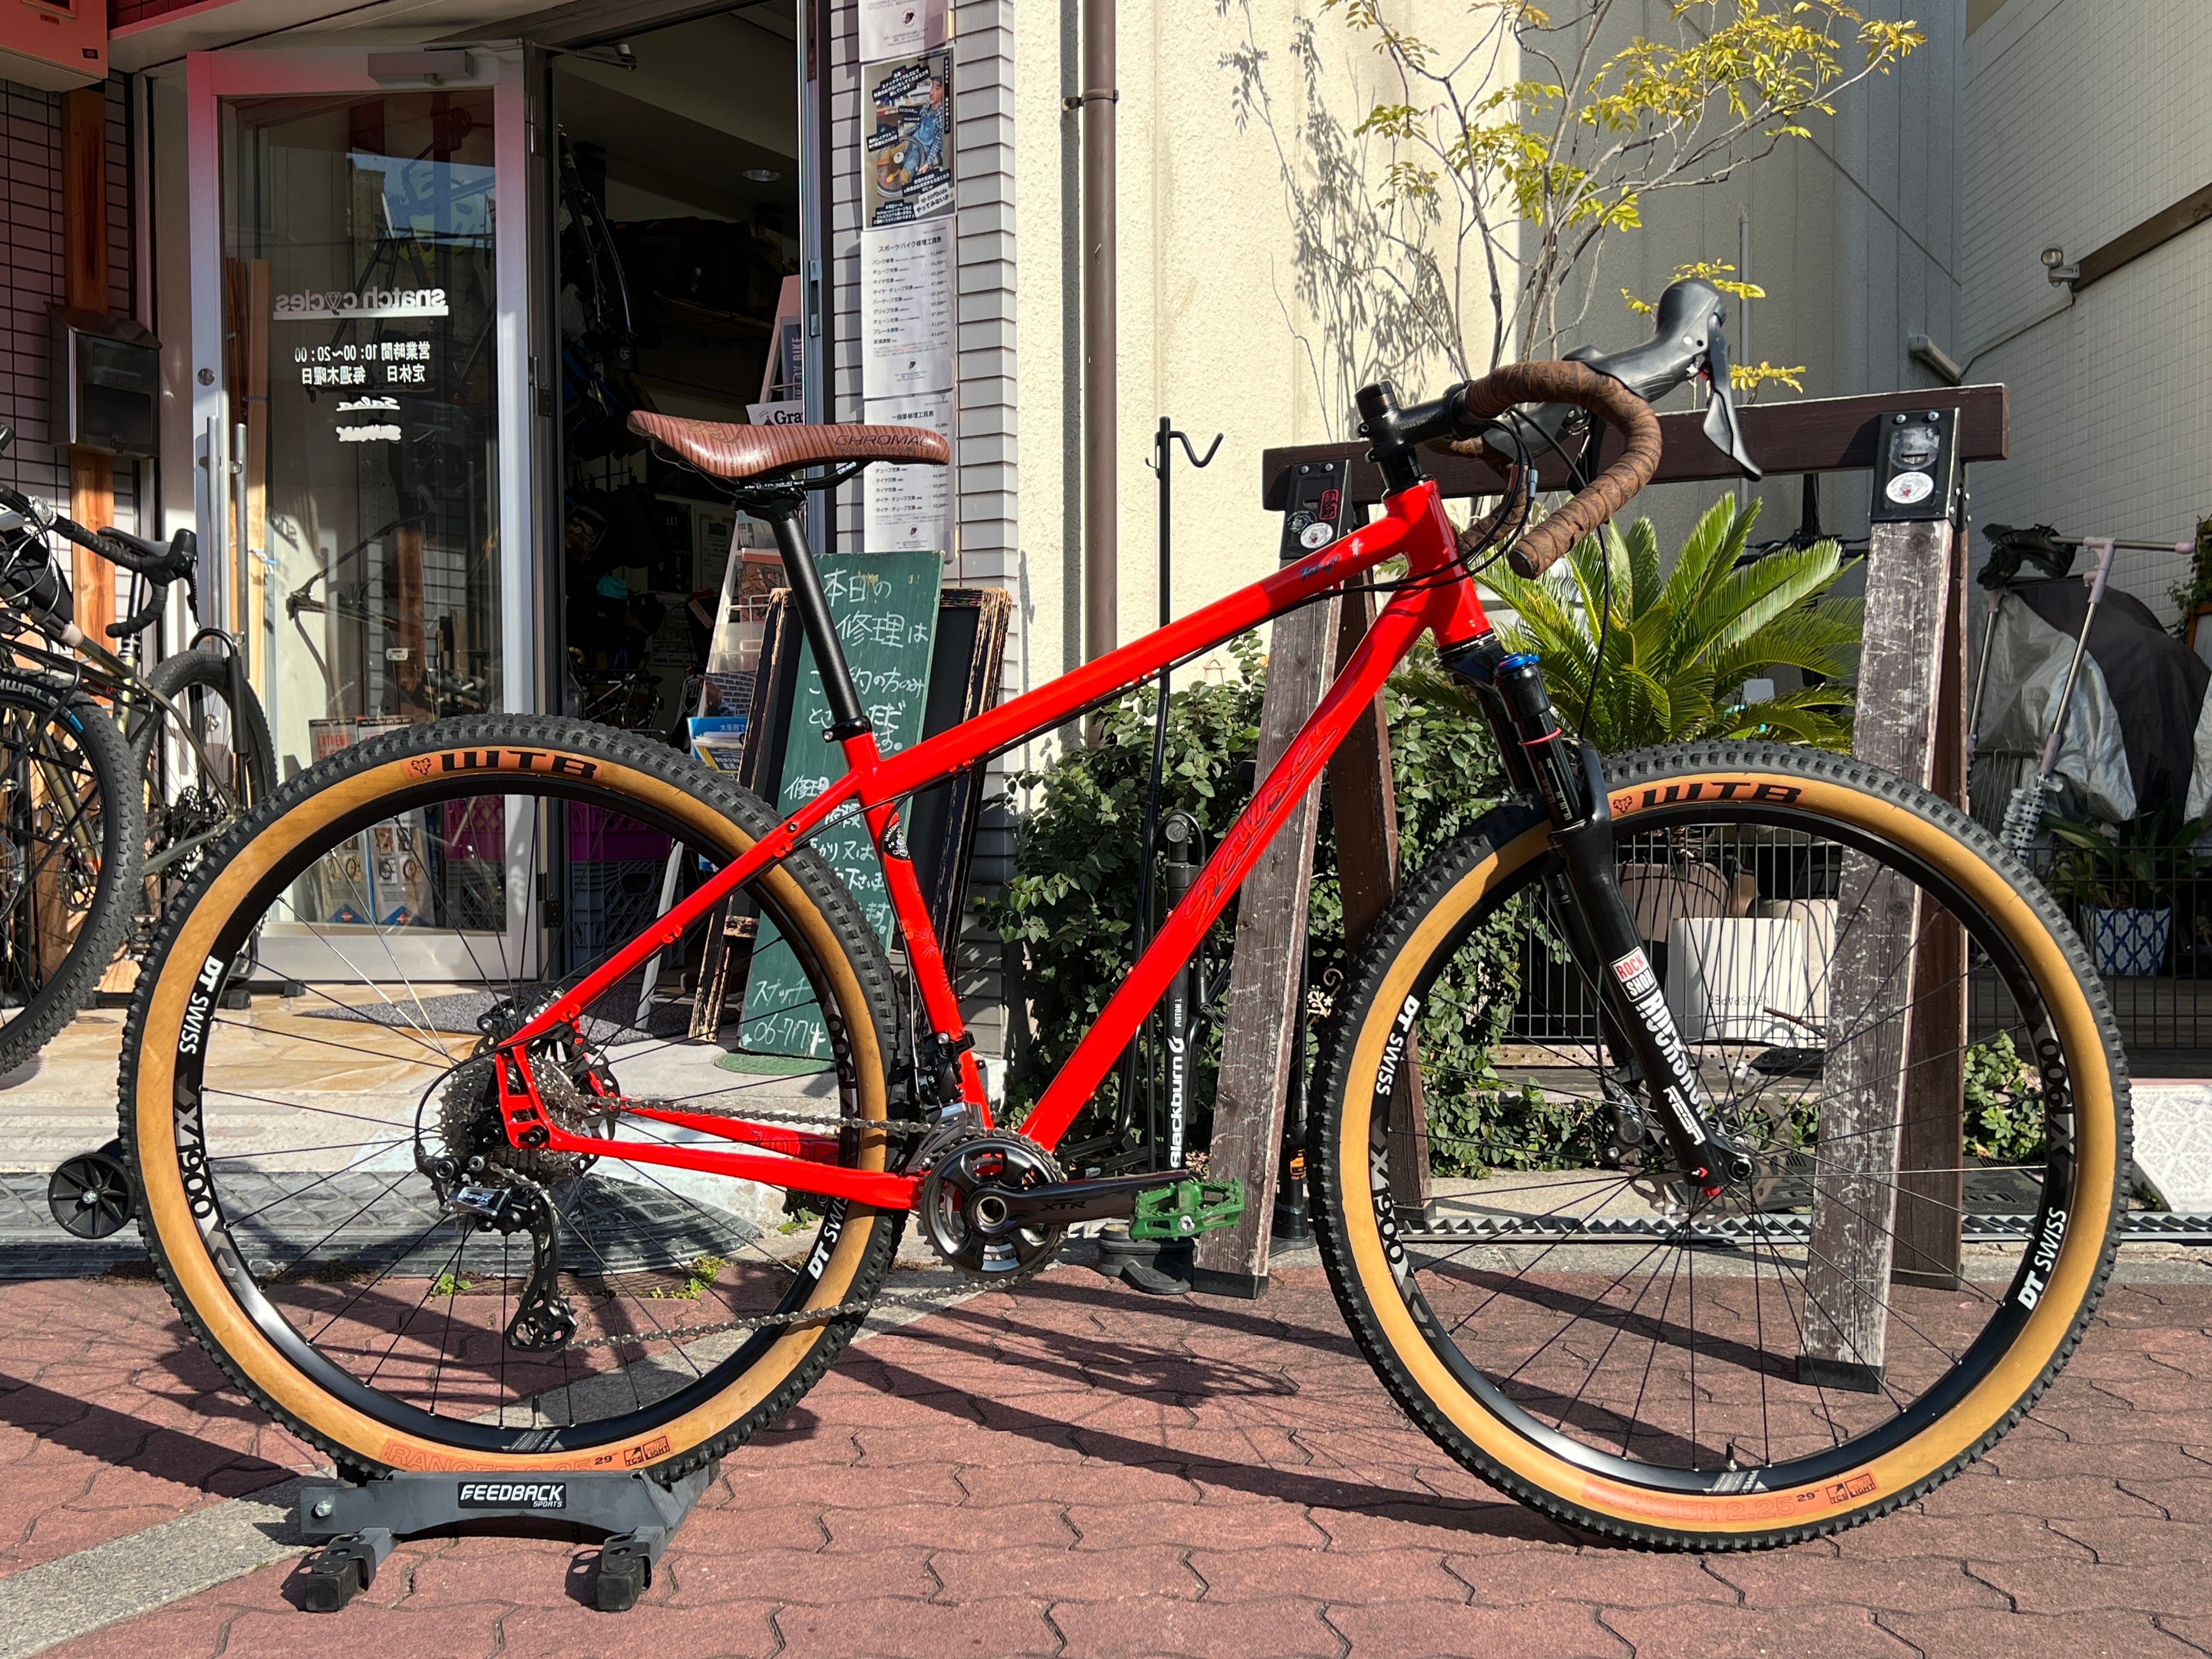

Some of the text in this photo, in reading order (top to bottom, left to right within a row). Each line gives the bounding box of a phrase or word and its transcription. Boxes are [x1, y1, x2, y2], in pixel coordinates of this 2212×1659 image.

[774, 410, 803, 425] Gra
[824, 568, 892, 607] 本日の
[836, 610, 929, 648] 修理は
[440, 750, 598, 780] WTB
[1641, 782, 1803, 808] WTB
[1615, 953, 1645, 980] ROCK
[1625, 968, 1655, 997] SHOX
[179, 955, 224, 1055] DT SWISS
[1376, 994, 1421, 1096] DT SWISS
[1170, 1055, 1183, 1169] Blackburn
[808, 1241, 831, 1280] DT
[2017, 1207, 2068, 1311] DT SWISS
[460, 1484, 565, 1501] FEEDBACK
[1726, 1495, 1796, 1521] 2.25
